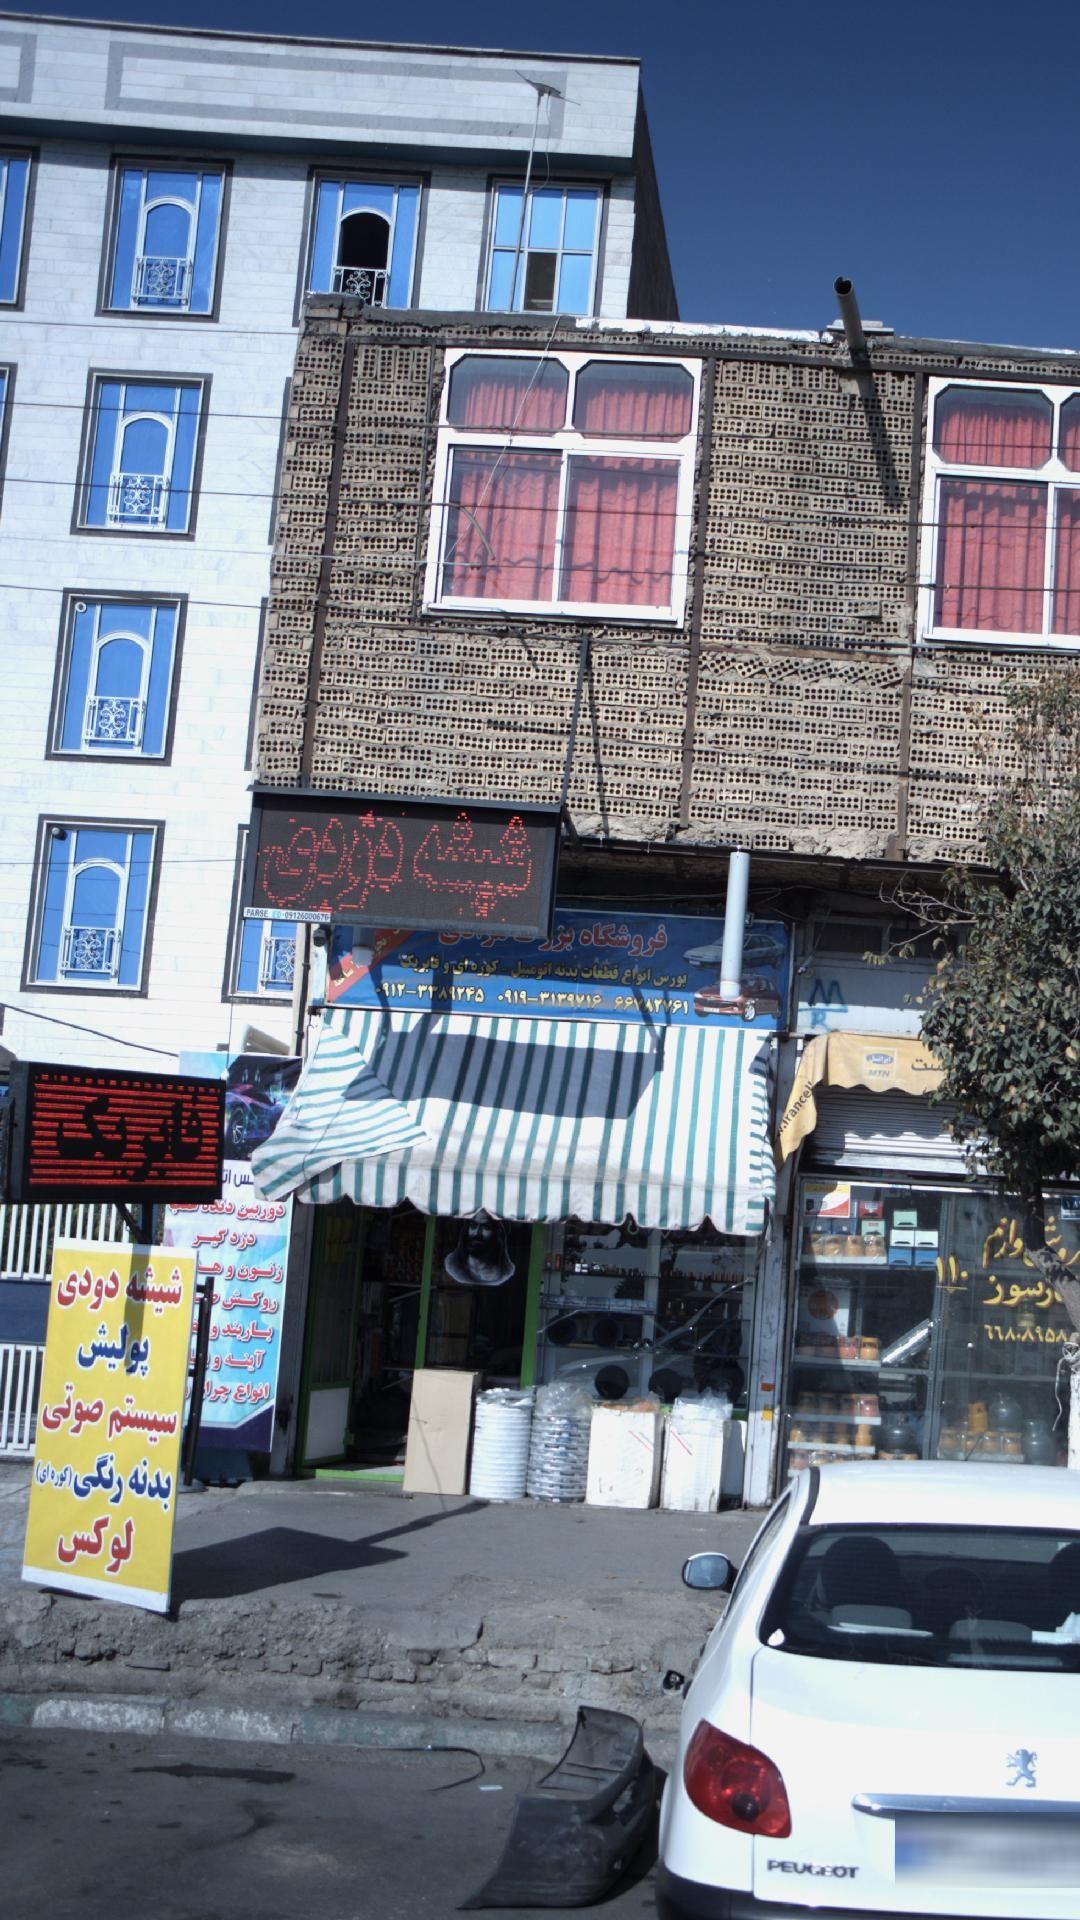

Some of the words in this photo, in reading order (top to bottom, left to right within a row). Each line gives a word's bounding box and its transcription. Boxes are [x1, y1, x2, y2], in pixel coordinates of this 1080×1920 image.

[579, 921, 668, 957] فروشگاه
[399, 953, 441, 973] فابریک
[443, 960, 450, 974] و
[511, 961, 552, 980] اتومبیل
[554, 964, 578, 980] بدنه
[581, 962, 619, 980] قطعات
[621, 967, 651, 986] انواع
[653, 973, 688, 988] بورس
[237, 1201, 286, 1221] دوربین
[224, 1264, 234, 1281] و
[237, 1261, 284, 1283] زنون
[57, 1268, 120, 1311] دودی
[125, 1266, 182, 1314] شیشه
[222, 1288, 279, 1312] روکش
[222, 1320, 273, 1343] باربند
[78, 1323, 150, 1376] پولیش
[213, 1355, 222, 1371] و
[224, 1350, 265, 1372] آینه
[233, 1382, 270, 1403] انواع
[41, 1384, 105, 1434] صوتی
[109, 1396, 178, 1443] سیستم
[73, 1454, 124, 1503] رنگی
[128, 1459, 172, 1510] بدنه
[57, 1516, 134, 1573] لوکس
[766, 1858, 860, 1880] PEUGEOT
